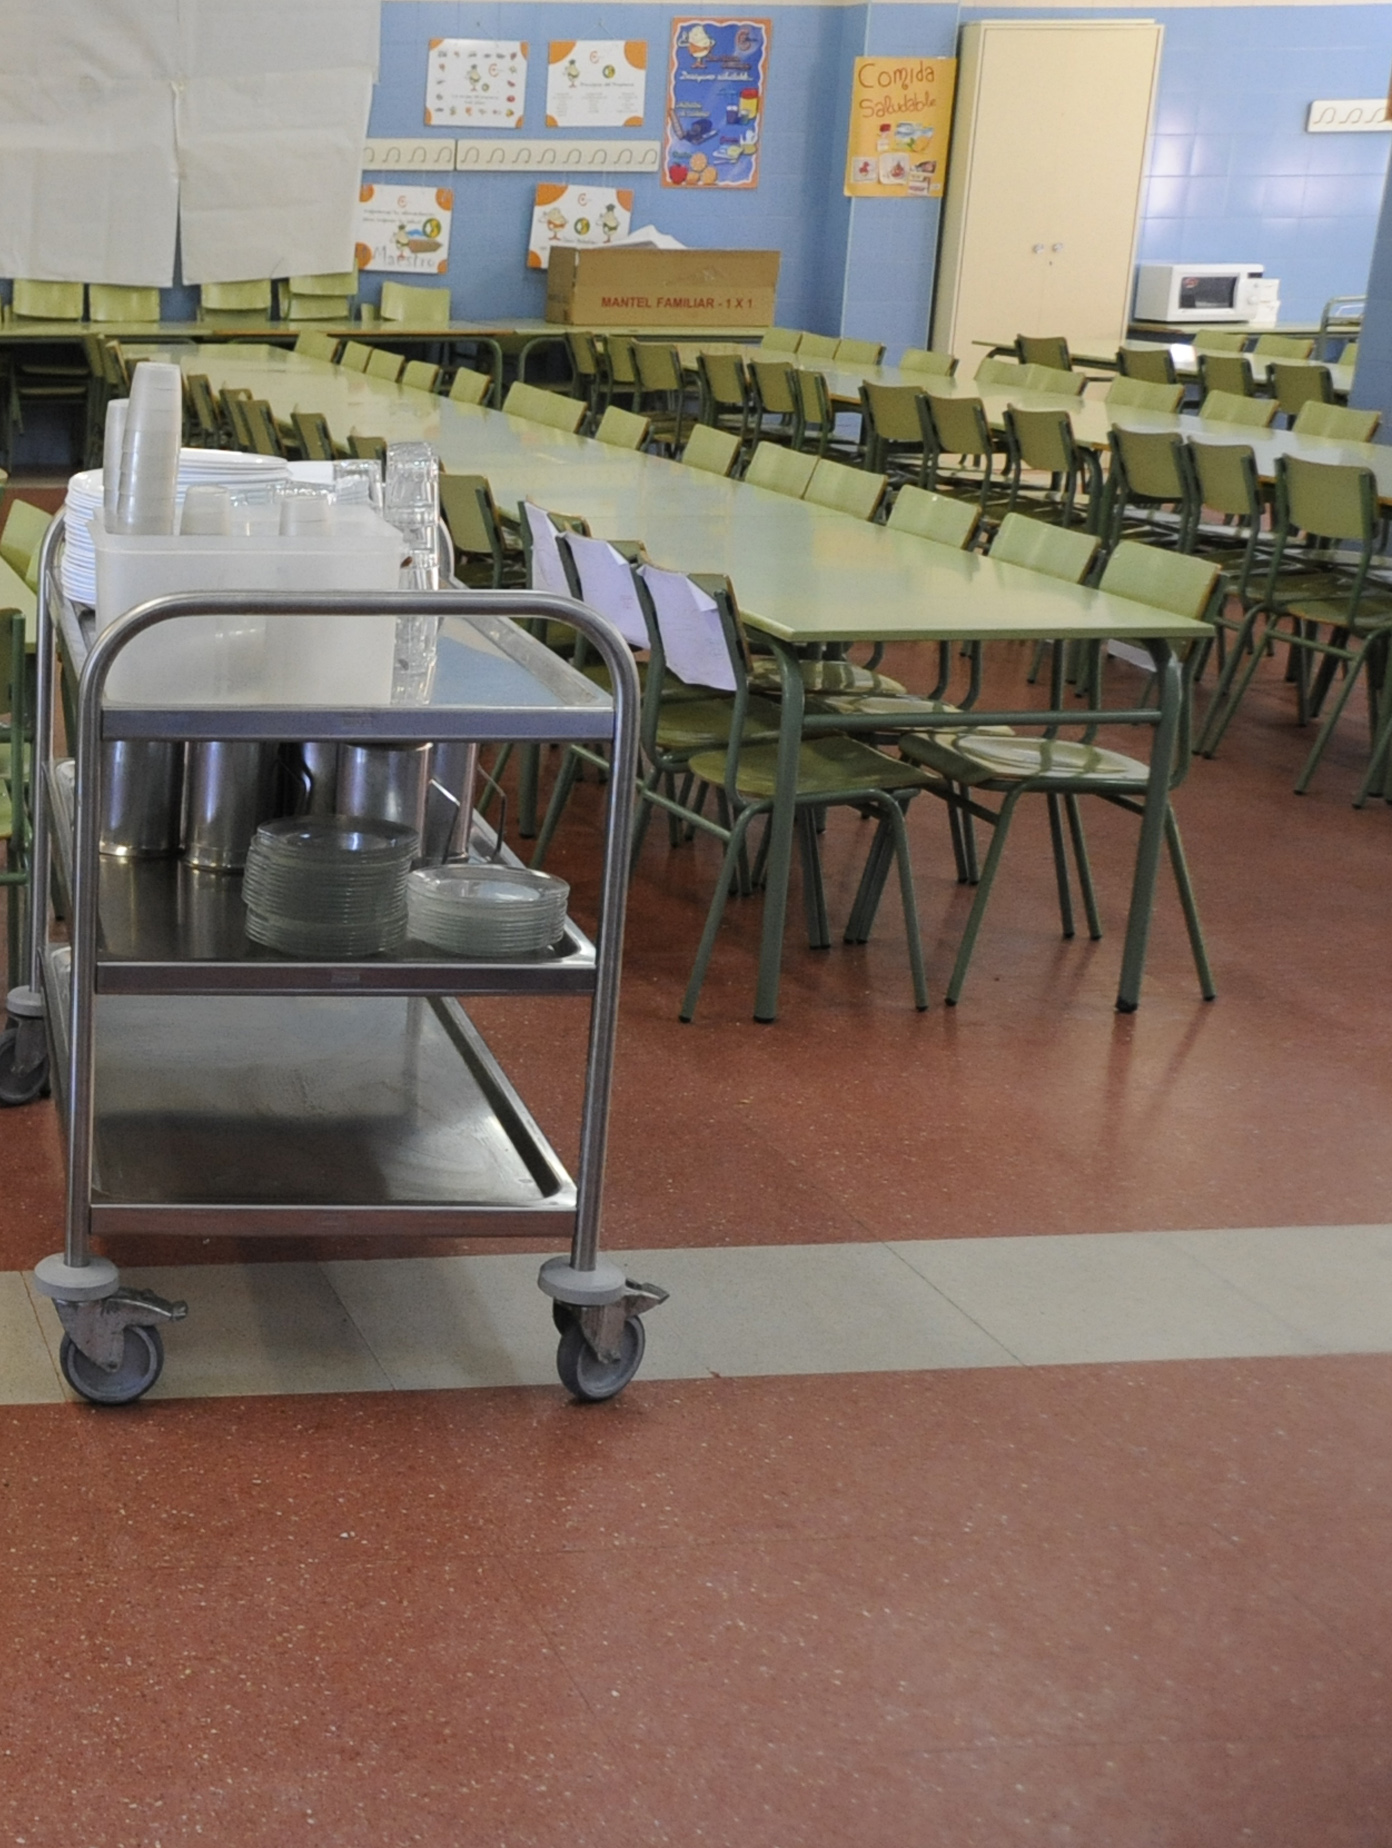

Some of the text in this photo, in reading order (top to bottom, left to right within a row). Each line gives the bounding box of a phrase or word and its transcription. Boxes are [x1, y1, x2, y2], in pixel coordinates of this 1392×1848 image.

[858, 61, 935, 90] Comida
[601, 297, 651, 308] MANTEL
[656, 297, 714, 308] FAMILIAR
[726, 298, 731, 308] 1
[735, 298, 743, 308] X
[748, 298, 753, 308] 1
